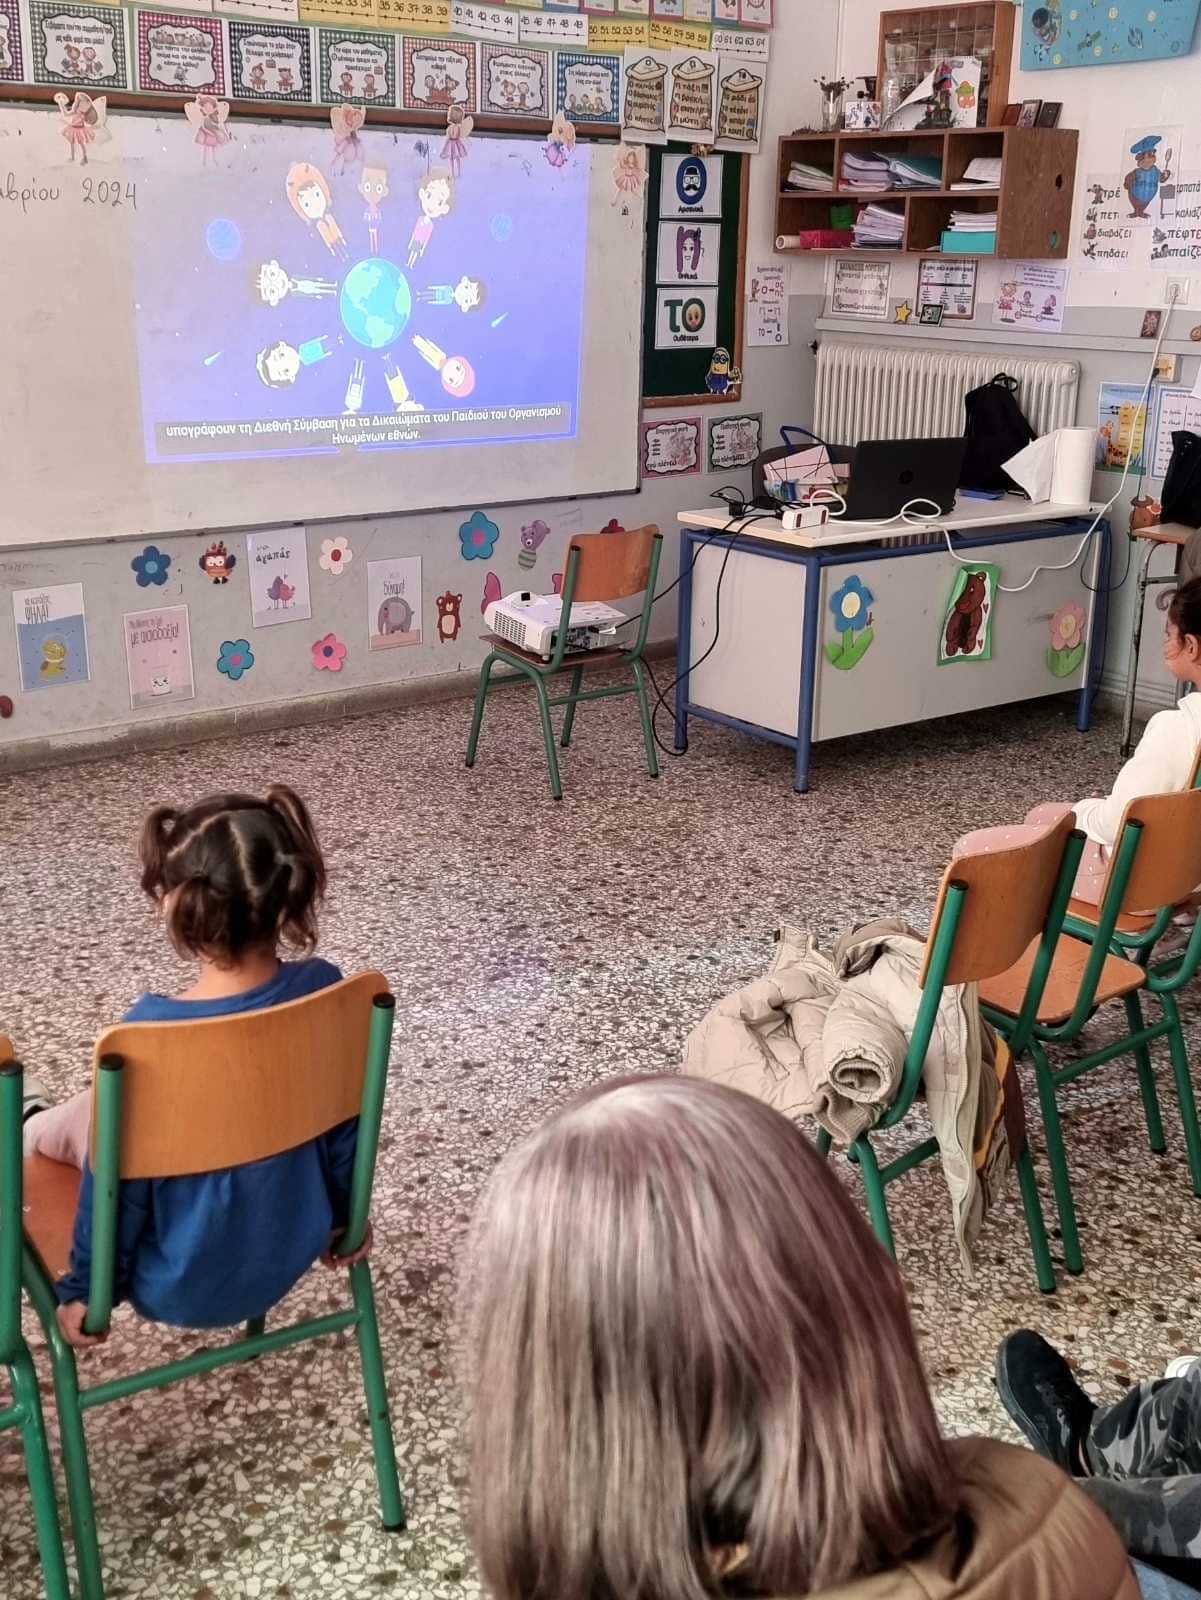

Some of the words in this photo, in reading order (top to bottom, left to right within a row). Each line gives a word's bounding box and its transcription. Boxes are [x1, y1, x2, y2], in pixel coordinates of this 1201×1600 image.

[379, 0, 390, 10] 35
[394, 1, 404, 11] 36
[408, 3, 419, 13] 37
[422, 5, 432, 15] 38
[436, 7, 447, 16] 39
[454, 6, 462, 16] 40
[466, 8, 473, 18] 41
[478, 10, 486, 20] 42
[491, 13, 500, 23] 43
[504, 16, 513, 26] 44
[521, 15, 529, 25] 45
[534, 16, 542, 26] 46
[547, 18, 556, 26] 47
[560, 19, 569, 28] 48
[574, 20, 583, 28] 49
[589, 25, 597, 33] 50
[600, 25, 608, 34] 51
[611, 26, 621, 35] 52
[623, 25, 632, 35] 53
[635, 25, 644, 35] 54
[651, 24, 660, 32] 55
[662, 26, 672, 35] 56
[674, 28, 684, 37] 57
[685, 30, 694, 40] 58
[698, 33, 707, 43] 59
[724, 34, 732, 44] 61
[735, 35, 744, 44] 62
[745, 35, 754, 44] 63
[756, 37, 765, 46] 64
[82, 177, 136, 210] 2024
[1098, 228, 1132, 239] διαβάζει
[1096, 248, 1129, 258] πηδάει
[166, 424, 236, 440] υπογράφουν
[239, 424, 252, 436] τη
[254, 420, 291, 434] Διεθνή
[295, 418, 338, 432] Σύμβαση
[340, 418, 356, 431] για
[359, 417, 370, 426] τα
[372, 414, 430, 428] Δικαιώματα
[433, 414, 449, 423] του
[452, 409, 490, 422] Παιδιού
[491, 411, 506, 420] του
[509, 405, 560, 420] Οργανισμού
[333, 431, 385, 446] Ηνωμένων
[387, 430, 421, 441] εθνών.
[256, 547, 290, 564] αγαπάς
